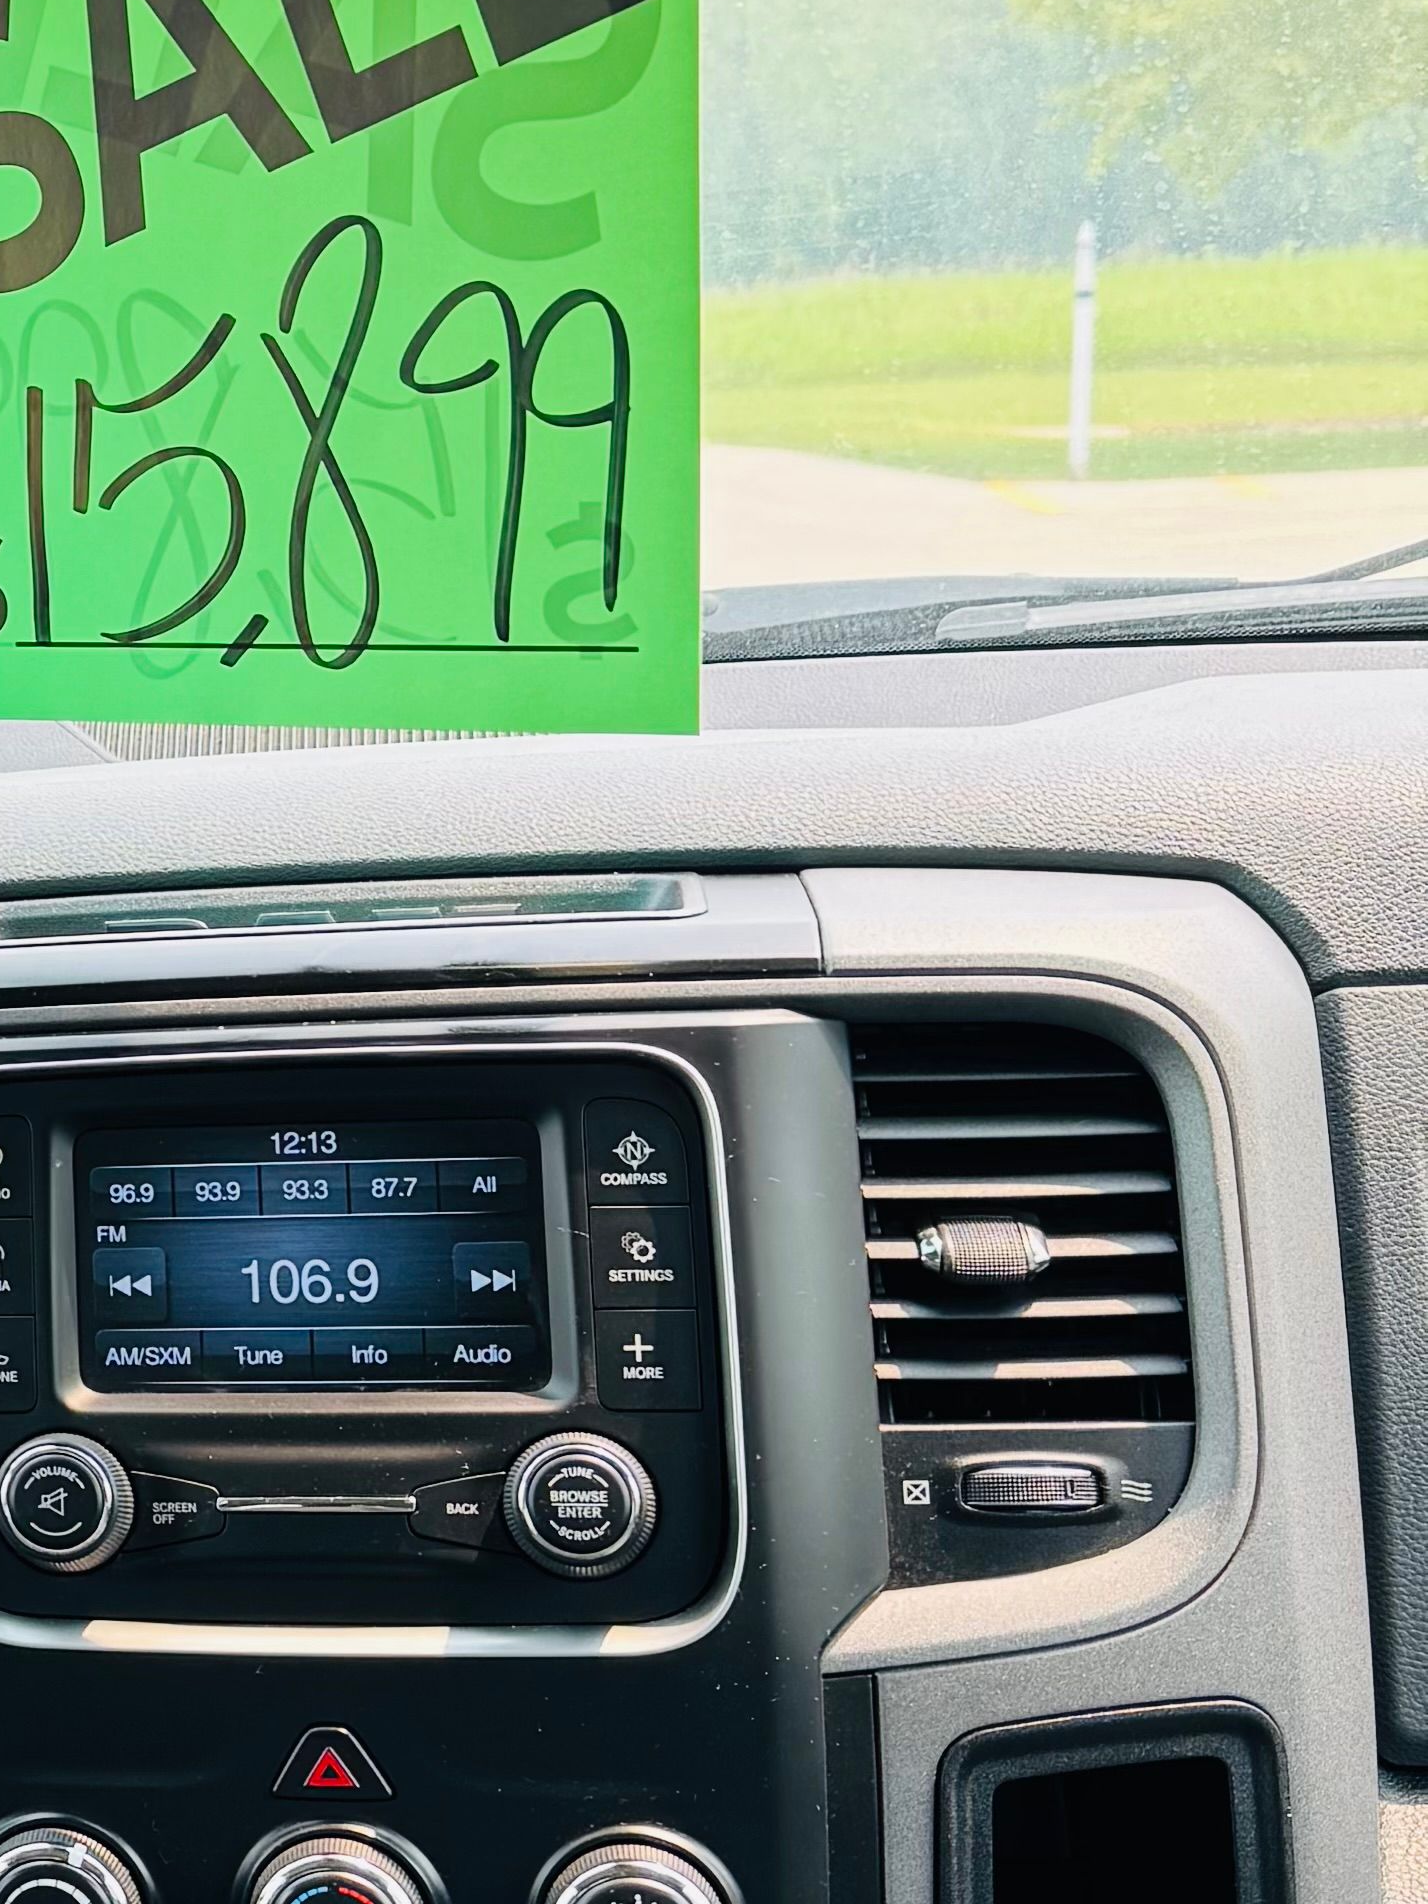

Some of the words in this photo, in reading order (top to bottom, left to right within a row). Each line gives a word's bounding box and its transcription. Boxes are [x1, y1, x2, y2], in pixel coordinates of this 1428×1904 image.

[271, 1131, 337, 1155] 12:13
[600, 1172, 668, 1186] COMPASS
[108, 1183, 155, 1204] 96.9
[195, 1180, 241, 1202] 93.9
[282, 1179, 329, 1201] 93.3
[370, 1177, 417, 1199] 87.7
[472, 1176, 497, 1195] All
[97, 1226, 126, 1243] FM
[241, 1258, 379, 1304] 106.9
[608, 1268, 674, 1284] SETTINGS
[105, 1345, 191, 1368] AM/SXM
[233, 1346, 283, 1366] Tune
[351, 1345, 388, 1365] Info
[453, 1344, 511, 1364] Audio
[622, 1366, 664, 1381] MORE
[30, 1465, 80, 1482] VOLUME
[560, 1466, 596, 1480] TUNE
[549, 1489, 609, 1505] BROWSE
[152, 1502, 197, 1514] SCREEN
[445, 1502, 479, 1515] BACK
[557, 1505, 603, 1519] ENTER
[153, 1513, 175, 1525] OFF
[558, 1521, 605, 1542] SCROLL
